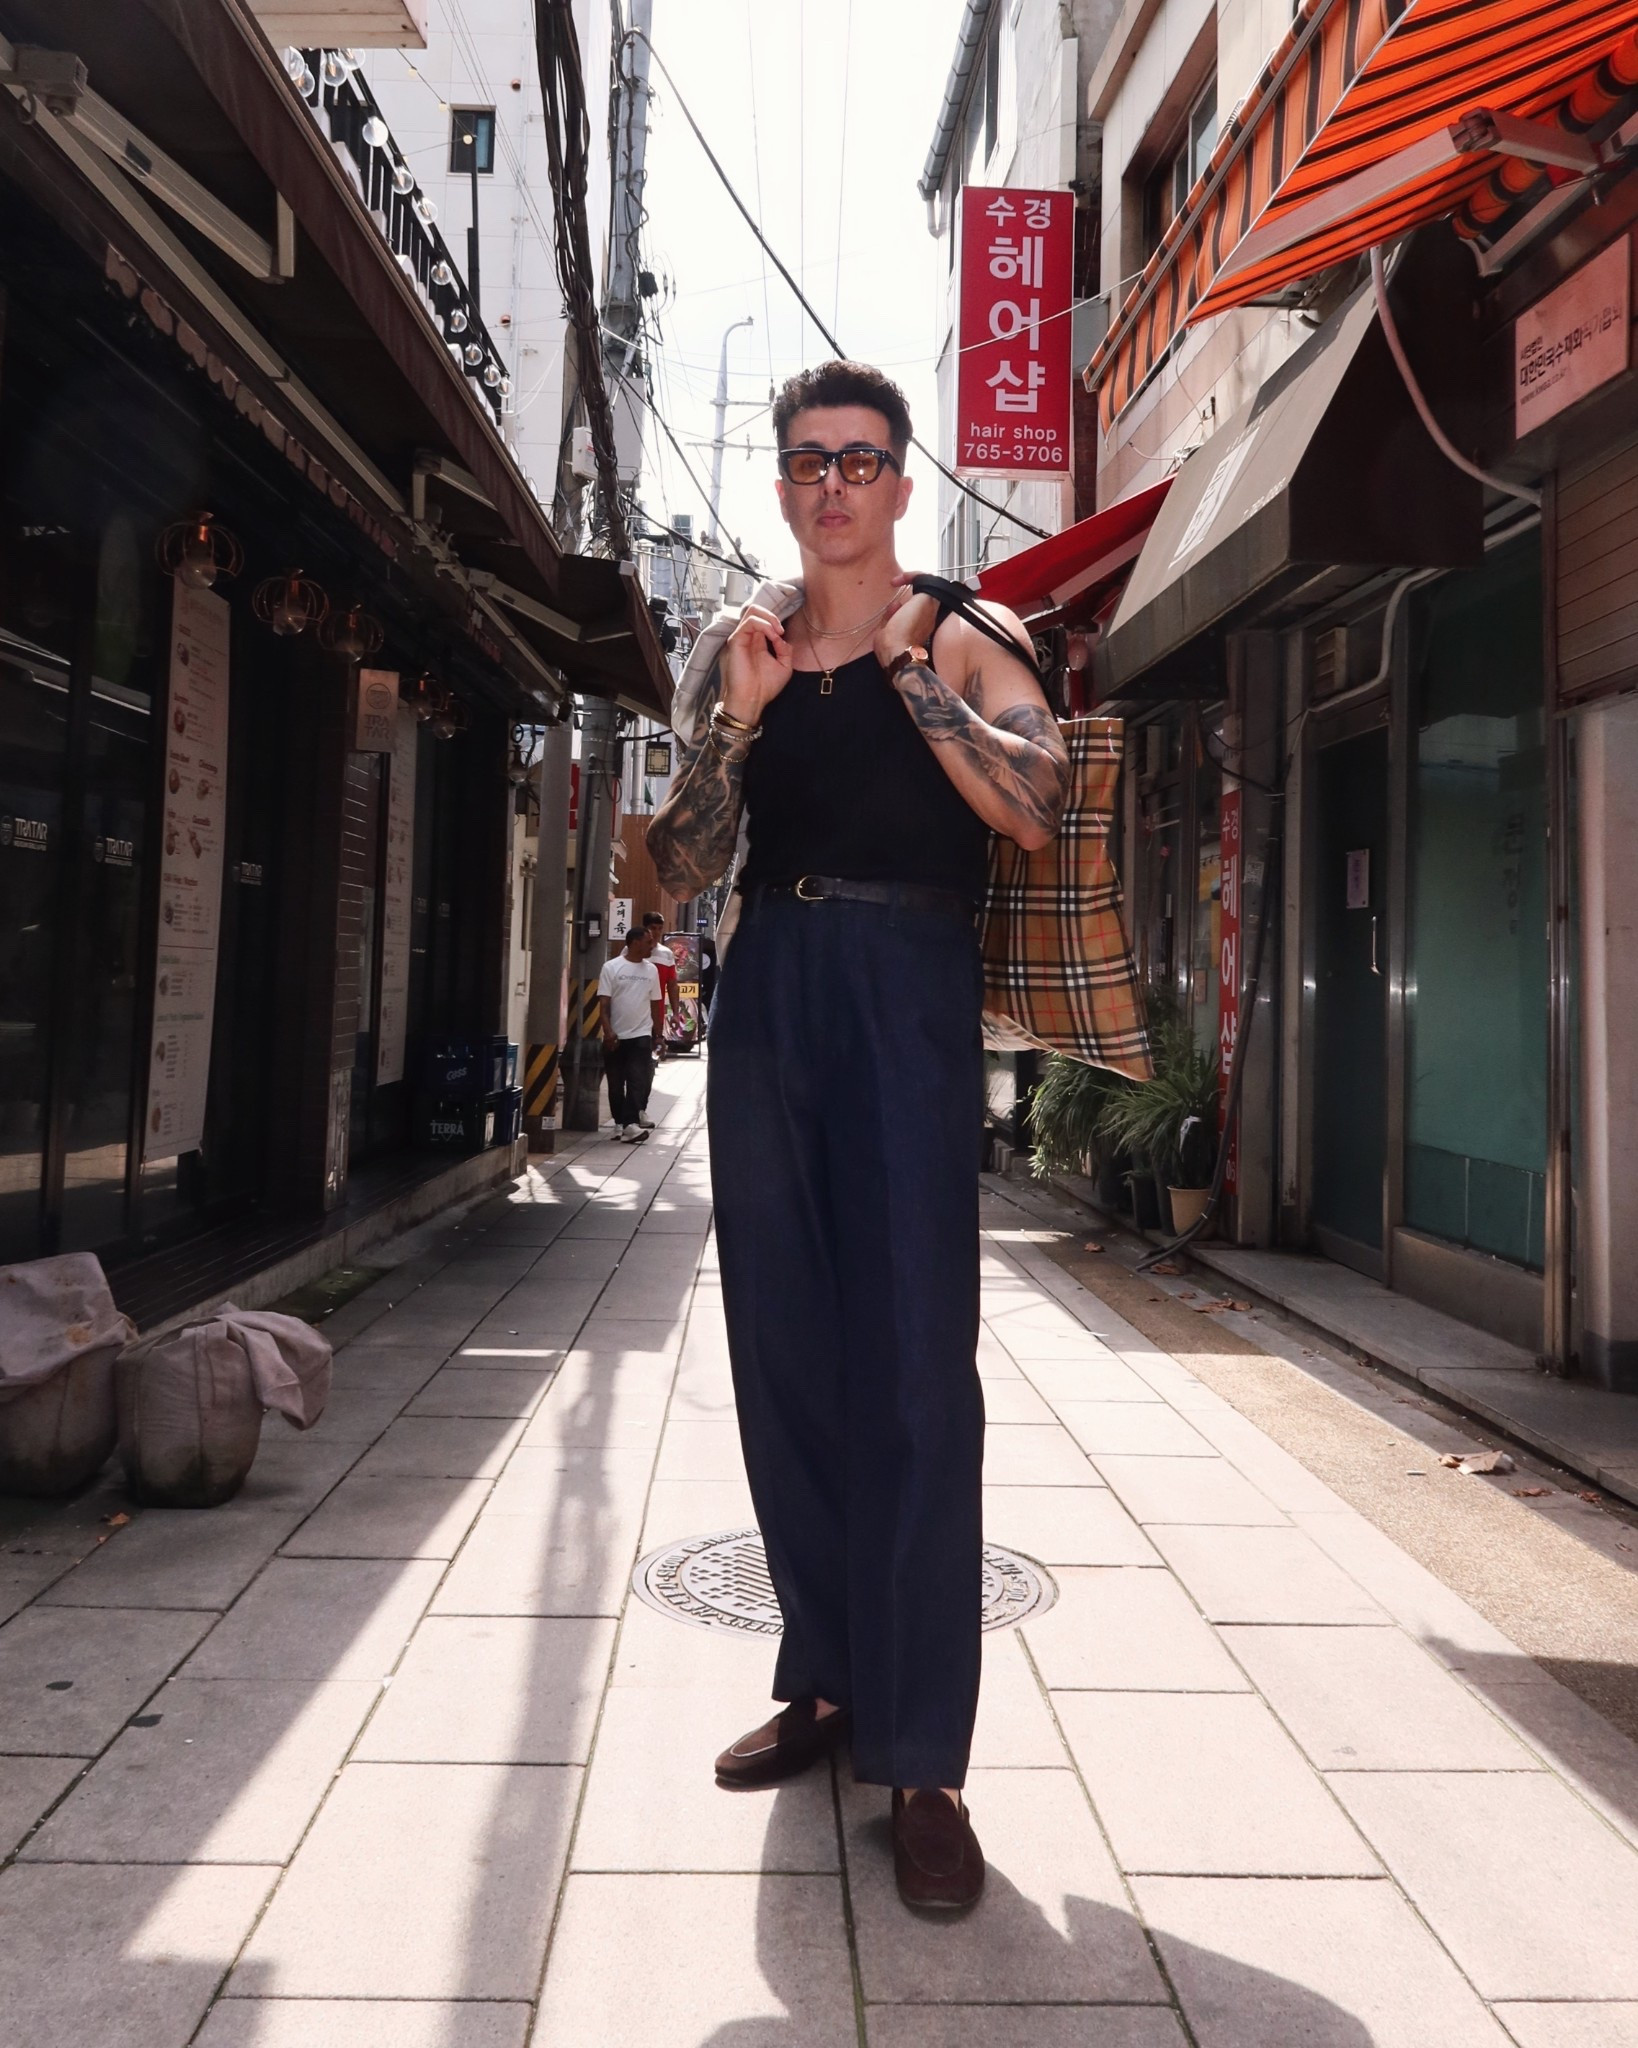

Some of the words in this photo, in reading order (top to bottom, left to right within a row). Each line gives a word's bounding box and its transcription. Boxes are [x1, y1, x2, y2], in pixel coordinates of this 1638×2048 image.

[985, 195, 1051, 230] 수경
[985, 235, 1047, 413] 헤어샵
[970, 422, 1006, 439] hair
[1013, 424, 1057, 443] shop
[964, 442, 1063, 464] 765-3706
[1222, 809, 1239, 841] 수경
[446, 1067, 468, 1081] Cass
[430, 1120, 465, 1136] TERRA
[657, 1555, 690, 1577] SEOUL
